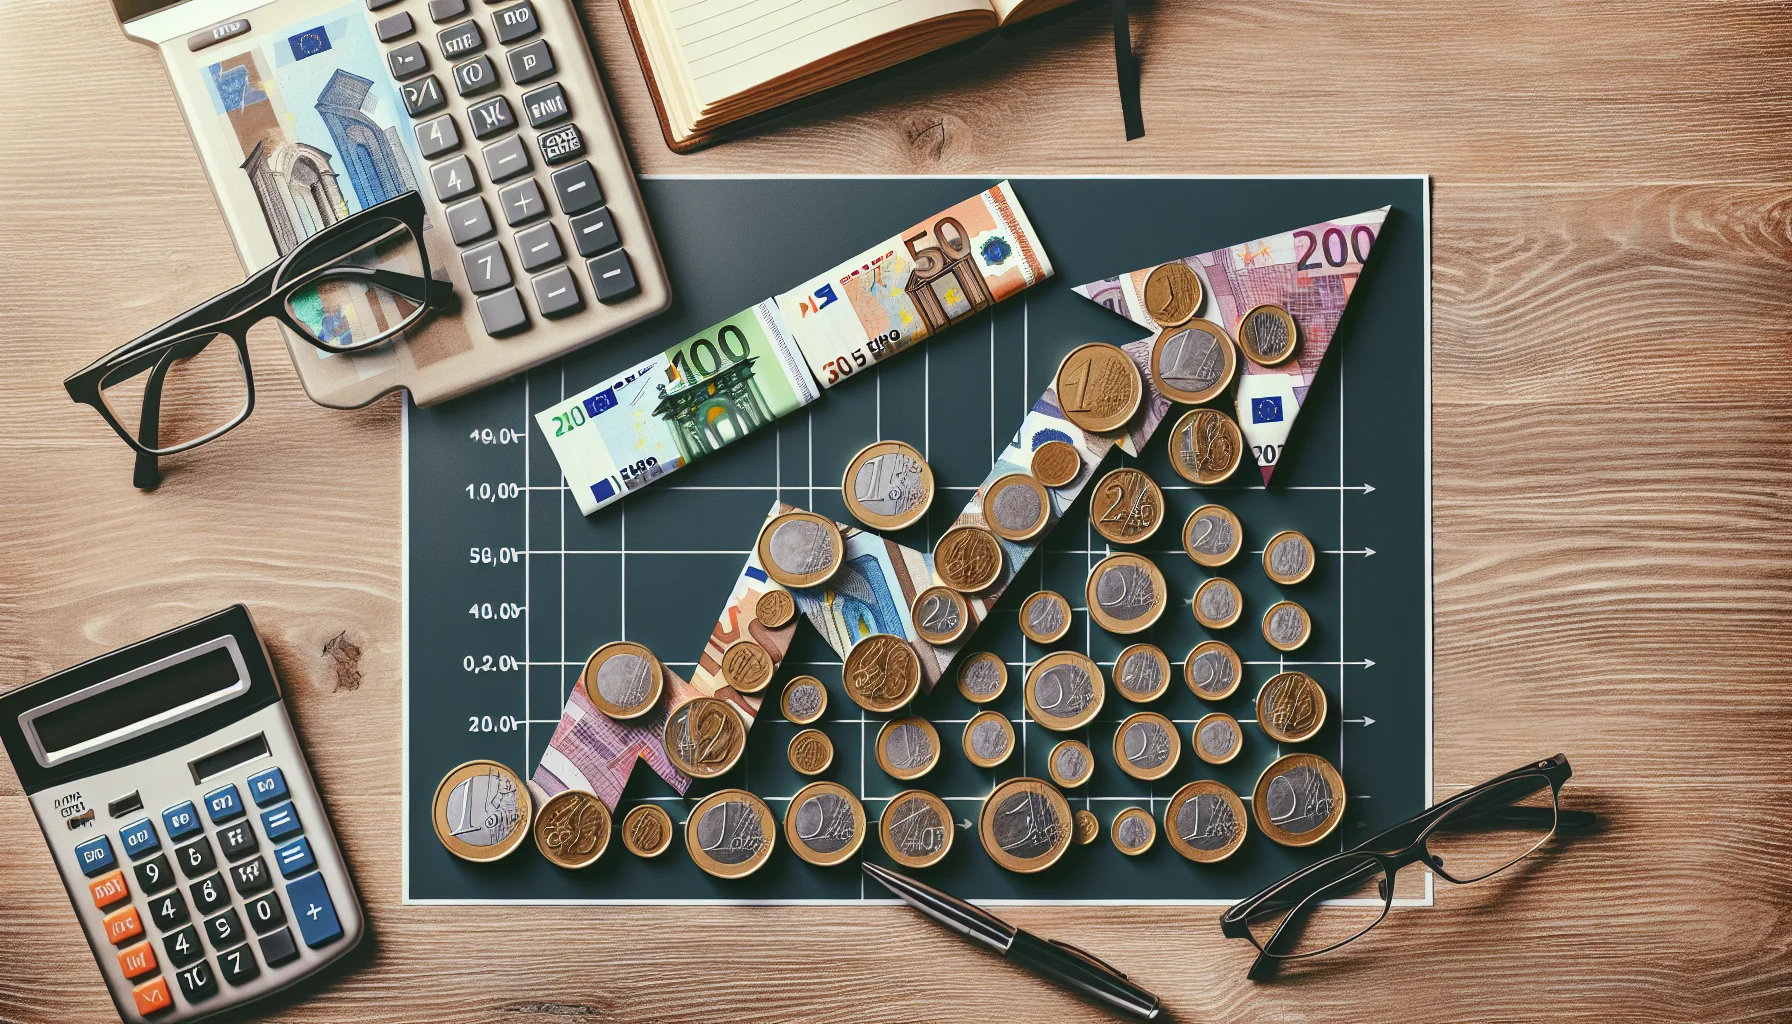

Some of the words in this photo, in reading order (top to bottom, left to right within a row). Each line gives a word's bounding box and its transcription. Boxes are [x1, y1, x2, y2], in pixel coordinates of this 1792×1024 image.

[904, 216, 971, 278] 50
[1292, 225, 1375, 272] 200
[478, 256, 493, 280] 7
[669, 324, 750, 384] 100
[147, 863, 159, 885] 9
[161, 898, 176, 920] 4
[256, 901, 271, 920] 0
[175, 933, 190, 955] 4
[229, 952, 242, 975] 7
